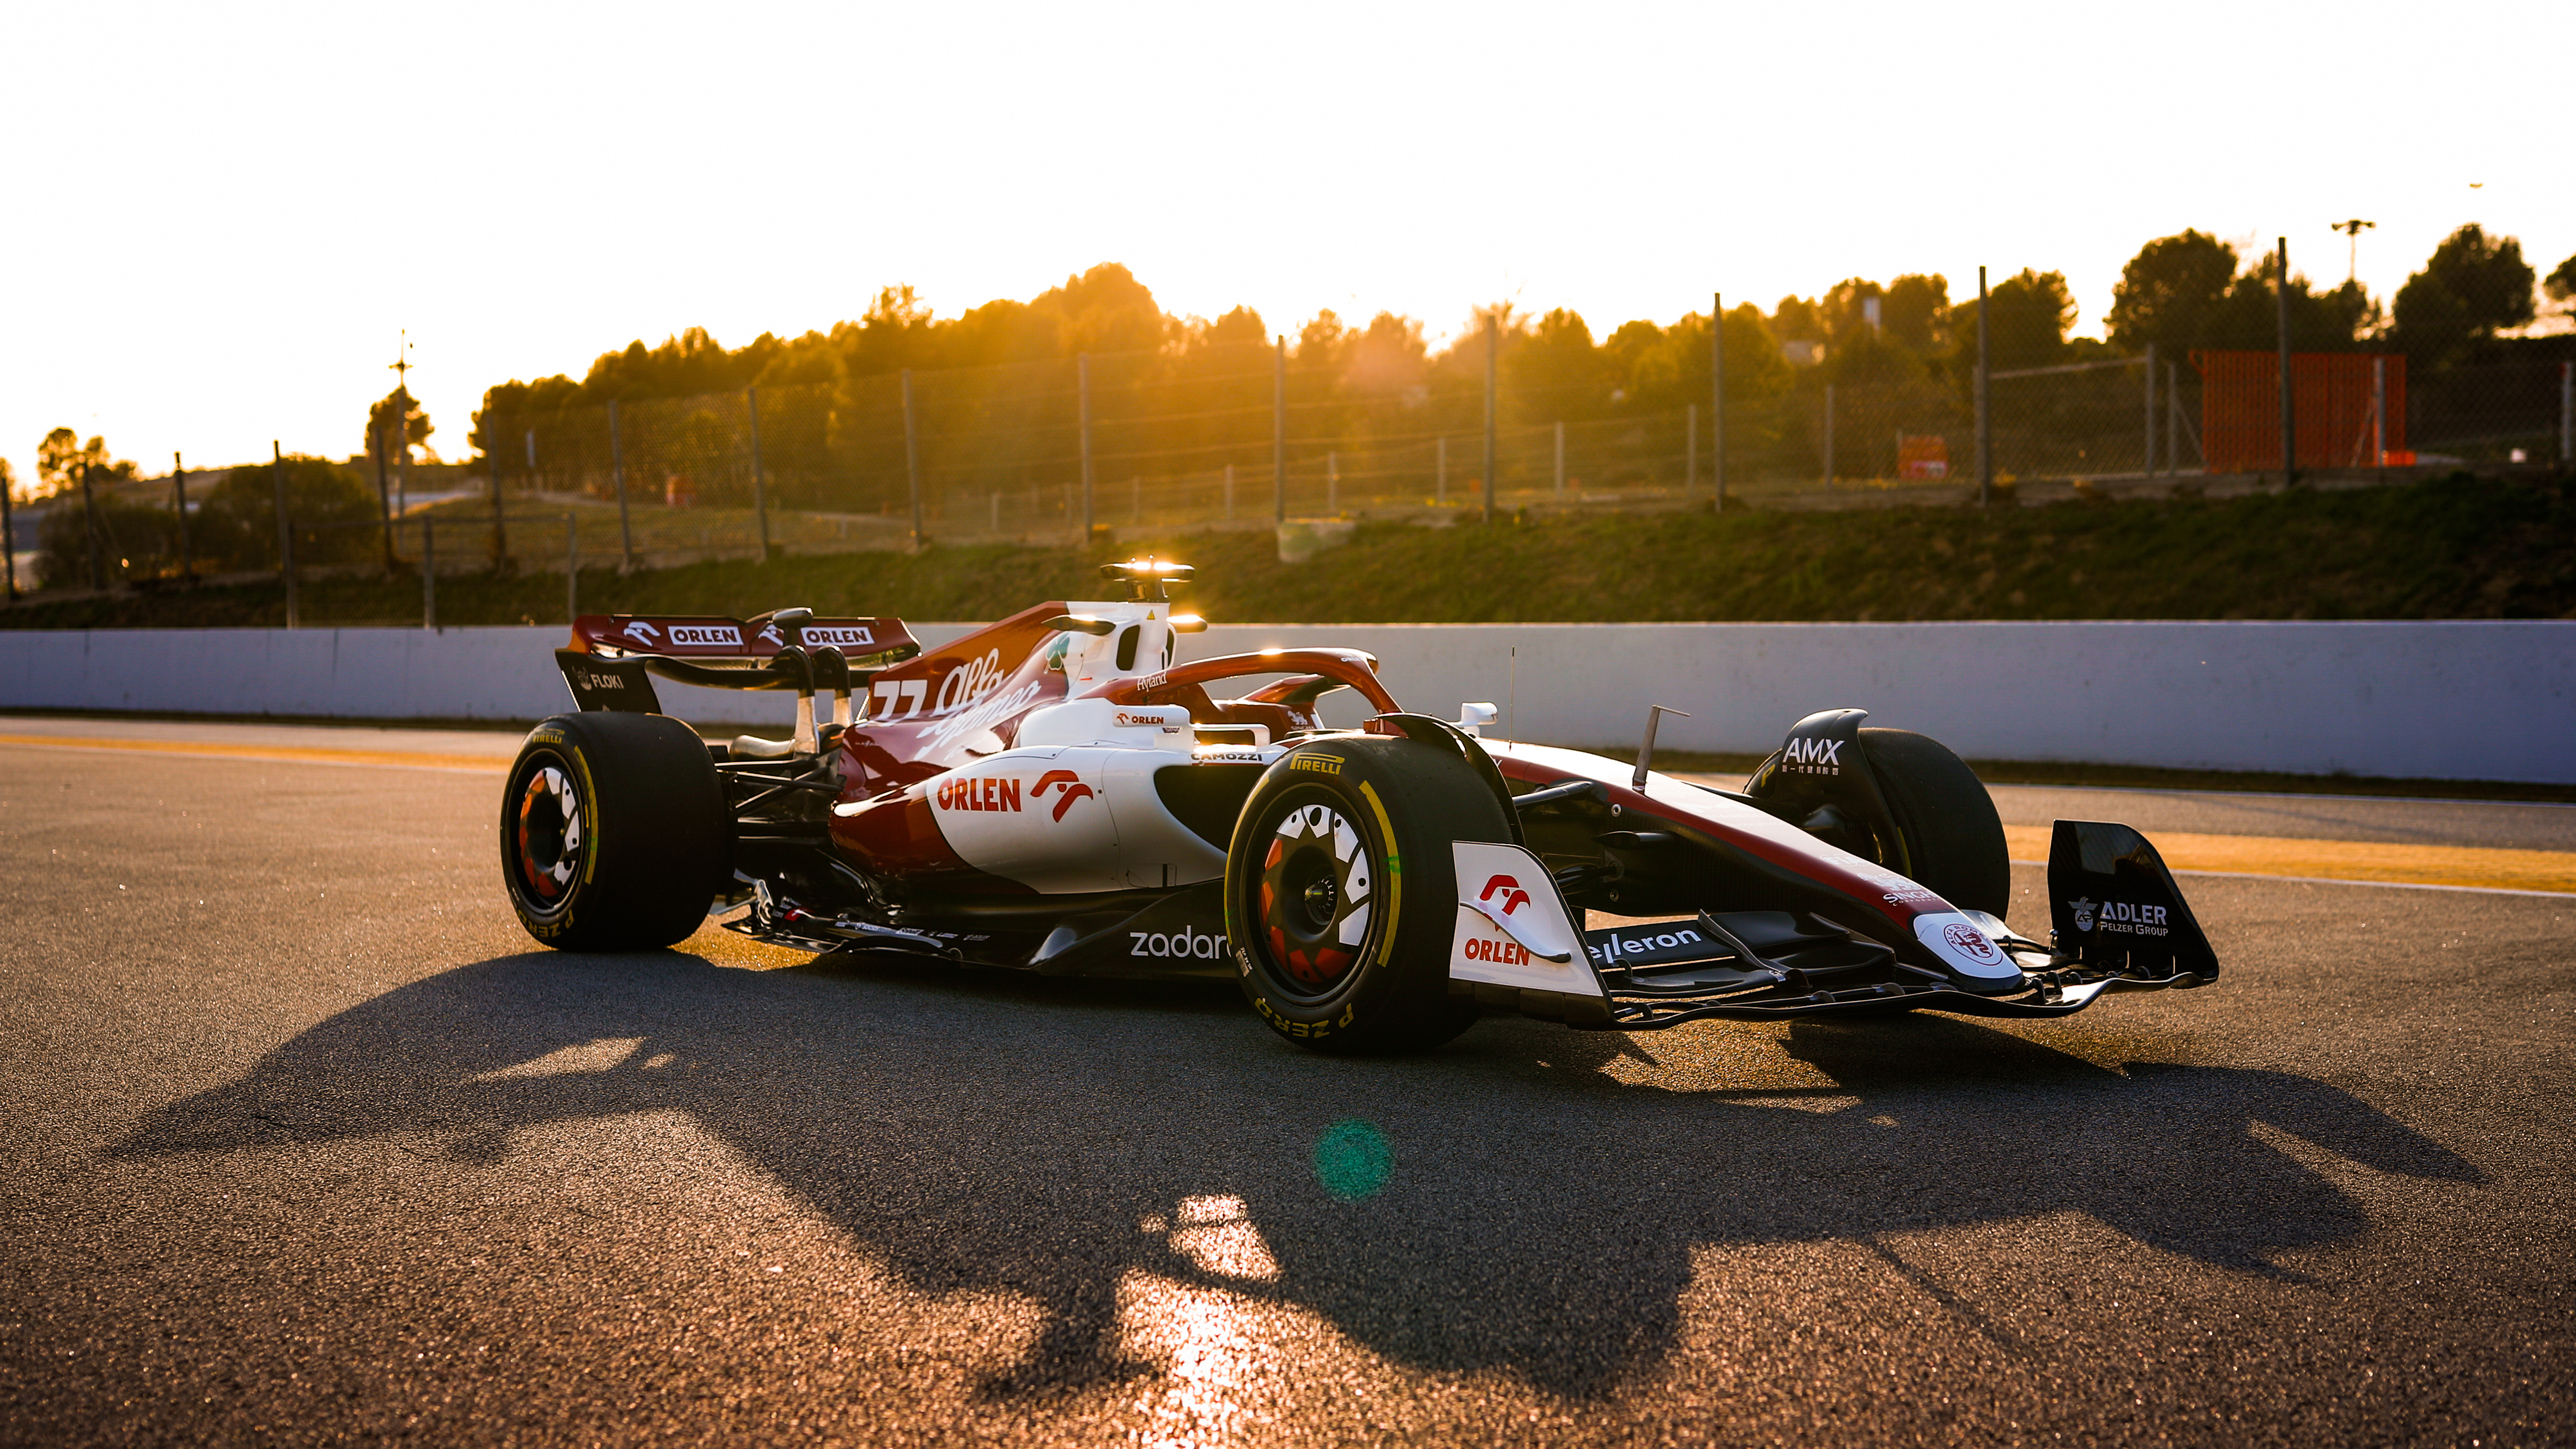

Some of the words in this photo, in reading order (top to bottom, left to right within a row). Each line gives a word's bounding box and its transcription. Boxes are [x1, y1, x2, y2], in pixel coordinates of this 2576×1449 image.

[674, 629, 738, 642] ORLEN
[807, 630, 868, 643] ORLEN
[590, 674, 624, 689] FLOKI
[1137, 671, 1167, 692] Hyland
[856, 680, 928, 727] 77
[1132, 715, 1164, 724] ORLEN
[533, 728, 565, 744] PIRELLI
[1190, 753, 1262, 762] CAMOZZI
[1782, 738, 1844, 765] AMX
[1290, 753, 1345, 775] PIRELLI
[938, 778, 1021, 812] ORLEN
[517, 909, 561, 937] ZERO
[2100, 901, 2167, 925] ADLER
[1947, 928, 1957, 945] ALFA
[2100, 921, 2133, 933] PELZER
[2136, 924, 2168, 936] GROUP
[1130, 925, 1231, 959] zadar
[1465, 938, 1530, 966] ORLEN
[1254, 998, 1330, 1038] ZERO
[1338, 1003, 1354, 1028] P
